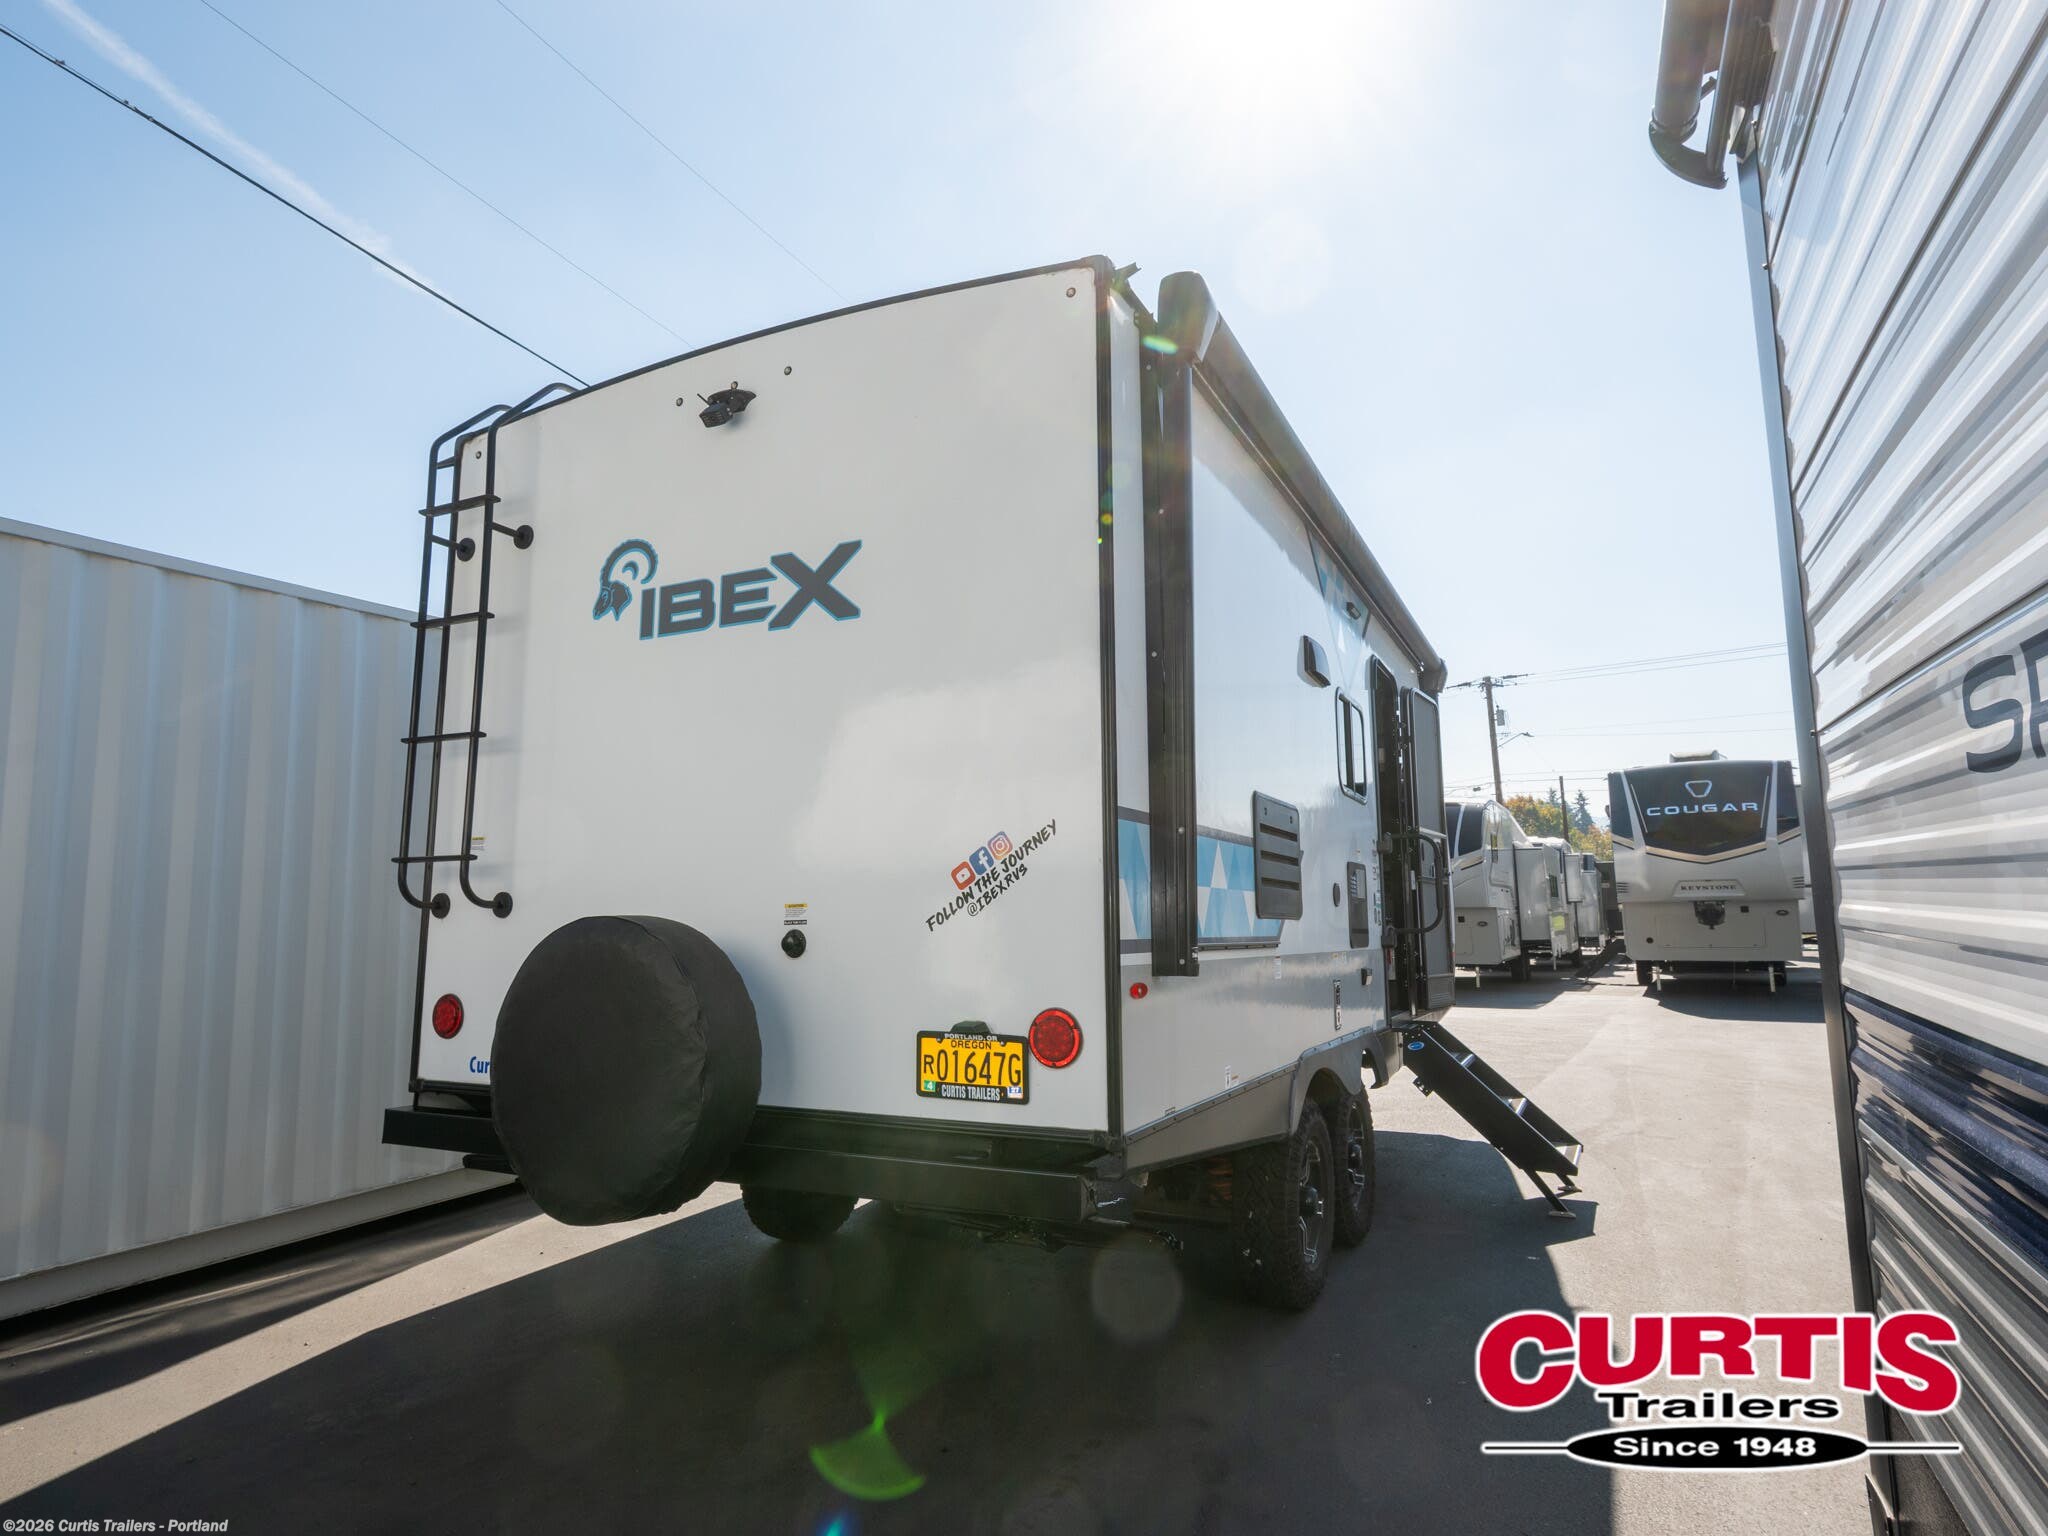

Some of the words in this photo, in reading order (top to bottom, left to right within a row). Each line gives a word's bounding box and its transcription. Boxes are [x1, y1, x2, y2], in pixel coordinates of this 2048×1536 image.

[638, 539, 863, 640] IBEX
[1646, 801, 1759, 816] COUGAR
[926, 886, 975, 932] FOLLOW
[974, 867, 1001, 893] THE
[1001, 819, 1057, 873] JOURNEY
[967, 863, 1028, 917] @IBEXRVS
[950, 1040, 992, 1050] OREGON
[469, 1055, 490, 1074] Cur
[923, 1049, 1022, 1086] R01647G
[941, 1084, 967, 1099] CURTIS
[968, 1086, 1001, 1101] TRAILERS
